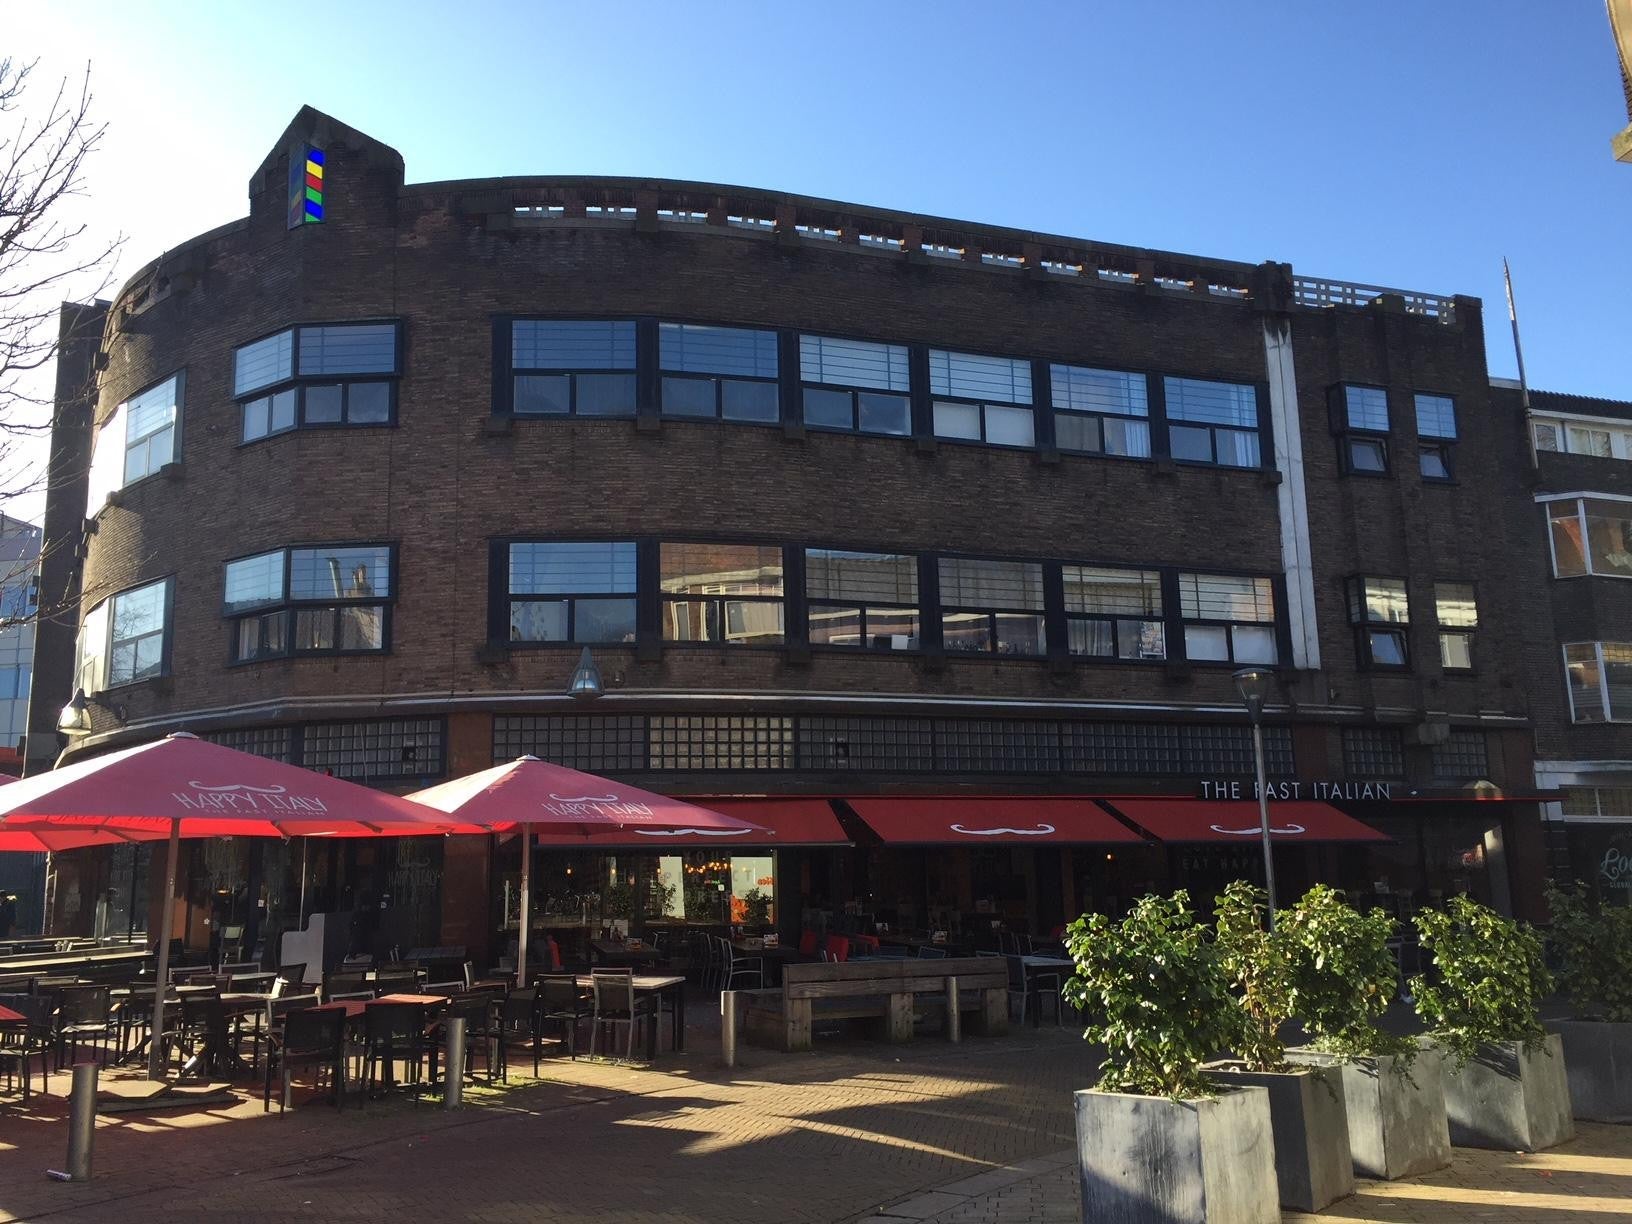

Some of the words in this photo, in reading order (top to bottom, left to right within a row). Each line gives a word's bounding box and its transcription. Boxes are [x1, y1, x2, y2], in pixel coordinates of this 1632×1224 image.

[1201, 781, 1240, 799] THE
[1254, 781, 1301, 800] FAST
[1313, 782, 1391, 800] ITALIAN
[172, 792, 258, 809] HAPPY
[258, 793, 328, 812] ITALY
[542, 802, 604, 816] HAPPY
[600, 802, 654, 816] ITALY
